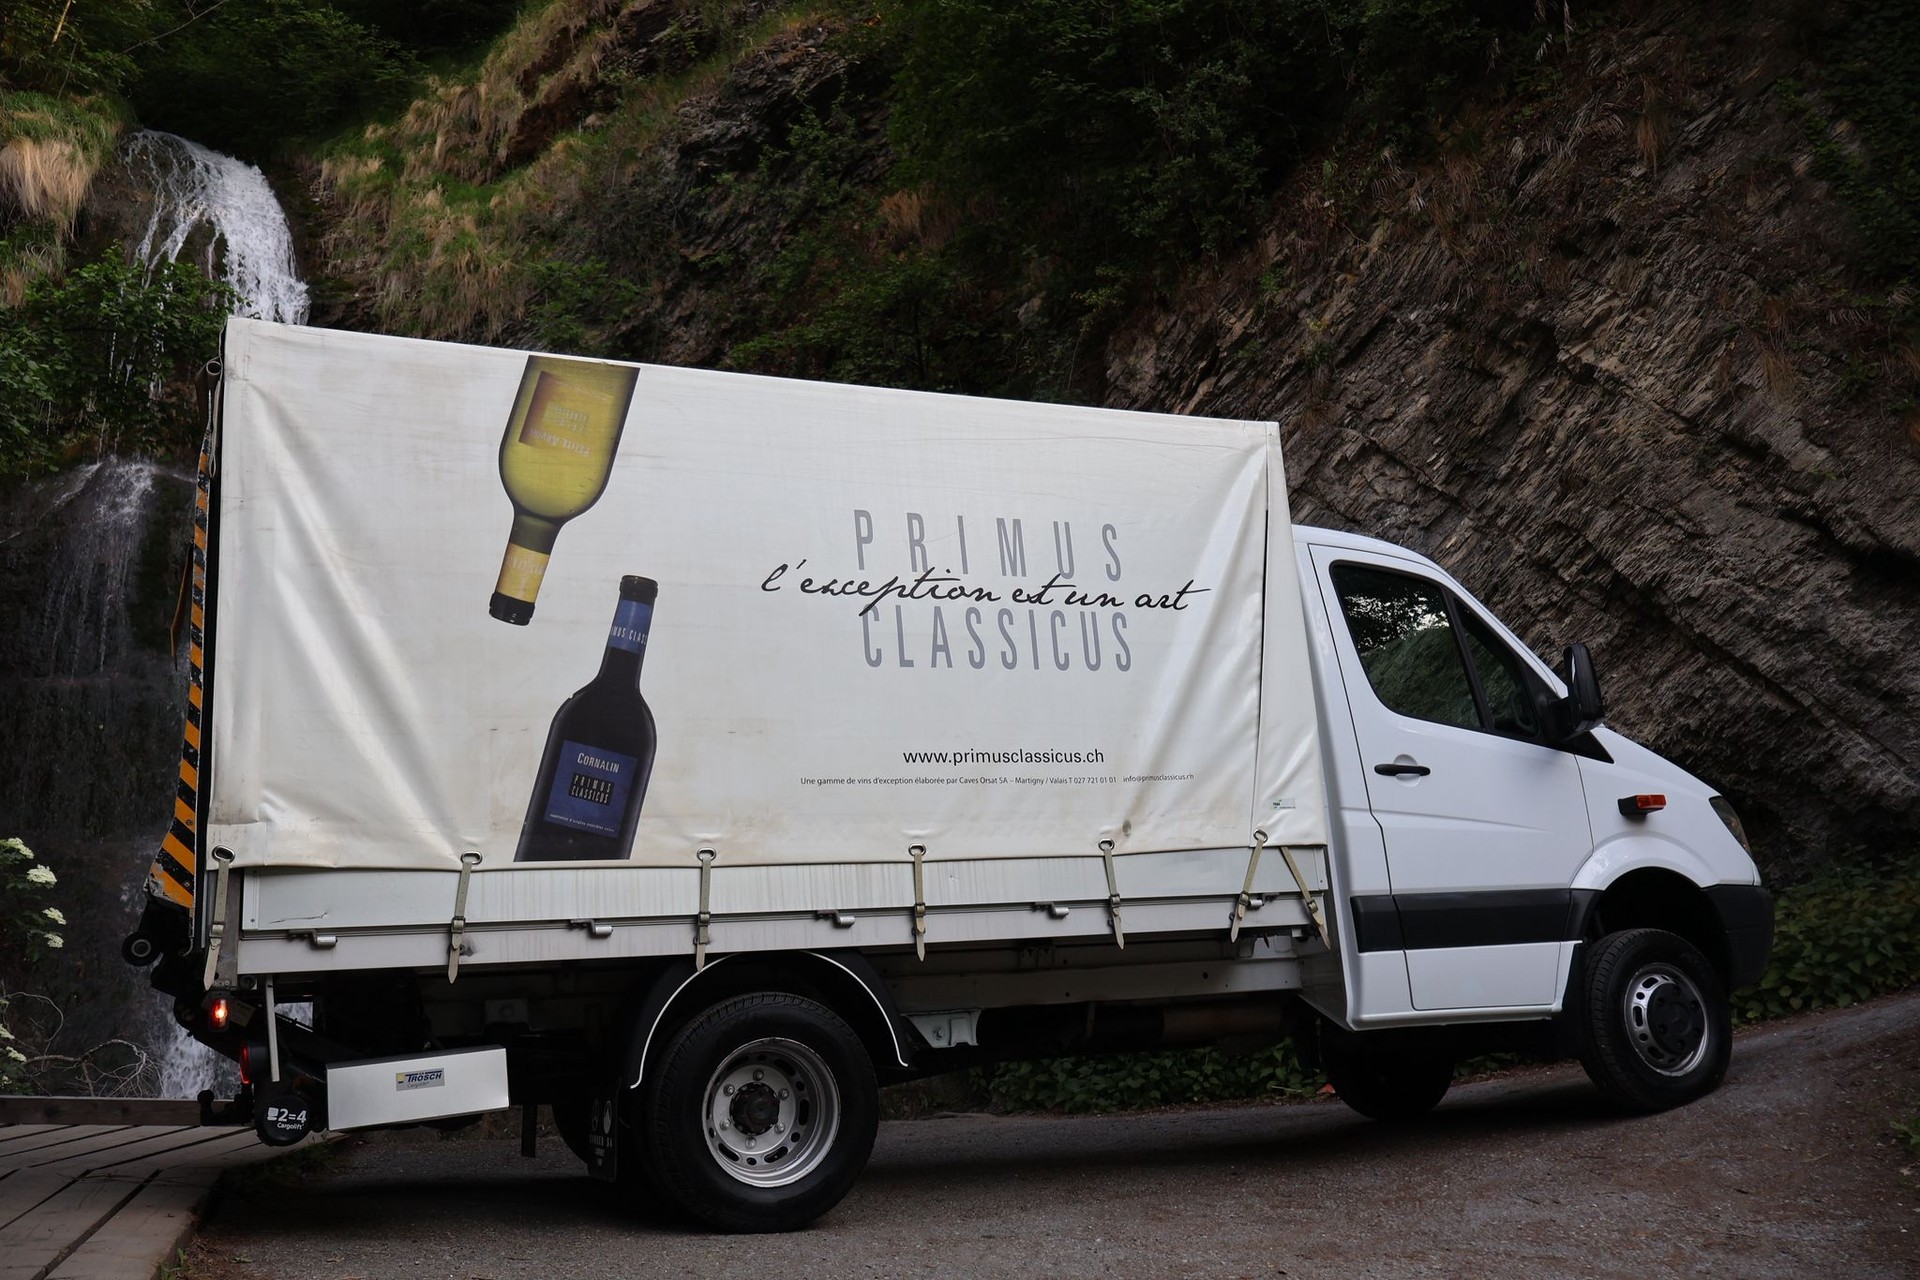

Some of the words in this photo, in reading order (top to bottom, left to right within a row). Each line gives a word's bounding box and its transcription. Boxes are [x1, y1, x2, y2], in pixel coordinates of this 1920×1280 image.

[853, 509, 1122, 582] PRIMUS
[760, 559, 1001, 617] l'exception
[1012, 573, 1066, 606] est
[1065, 588, 1125, 608] un
[1134, 579, 1211, 611] art
[861, 604, 1132, 672] CLASSICUS
[577, 752, 620, 773] CORNALIN
[903, 748, 1105, 766] www.primusclassicus.ch
[574, 775, 612, 793] PRIMUS
[817, 778, 845, 786] gamme
[873, 777, 914, 786] d'exception
[915, 776, 945, 784] élaborée
[946, 778, 958, 786] par
[1014, 776, 1044, 786] Martigny
[571, 785, 609, 804] CLASSICUS
[405, 1070, 443, 1082] TRÖSCH
[278, 1108, 307, 1123] 2=4
